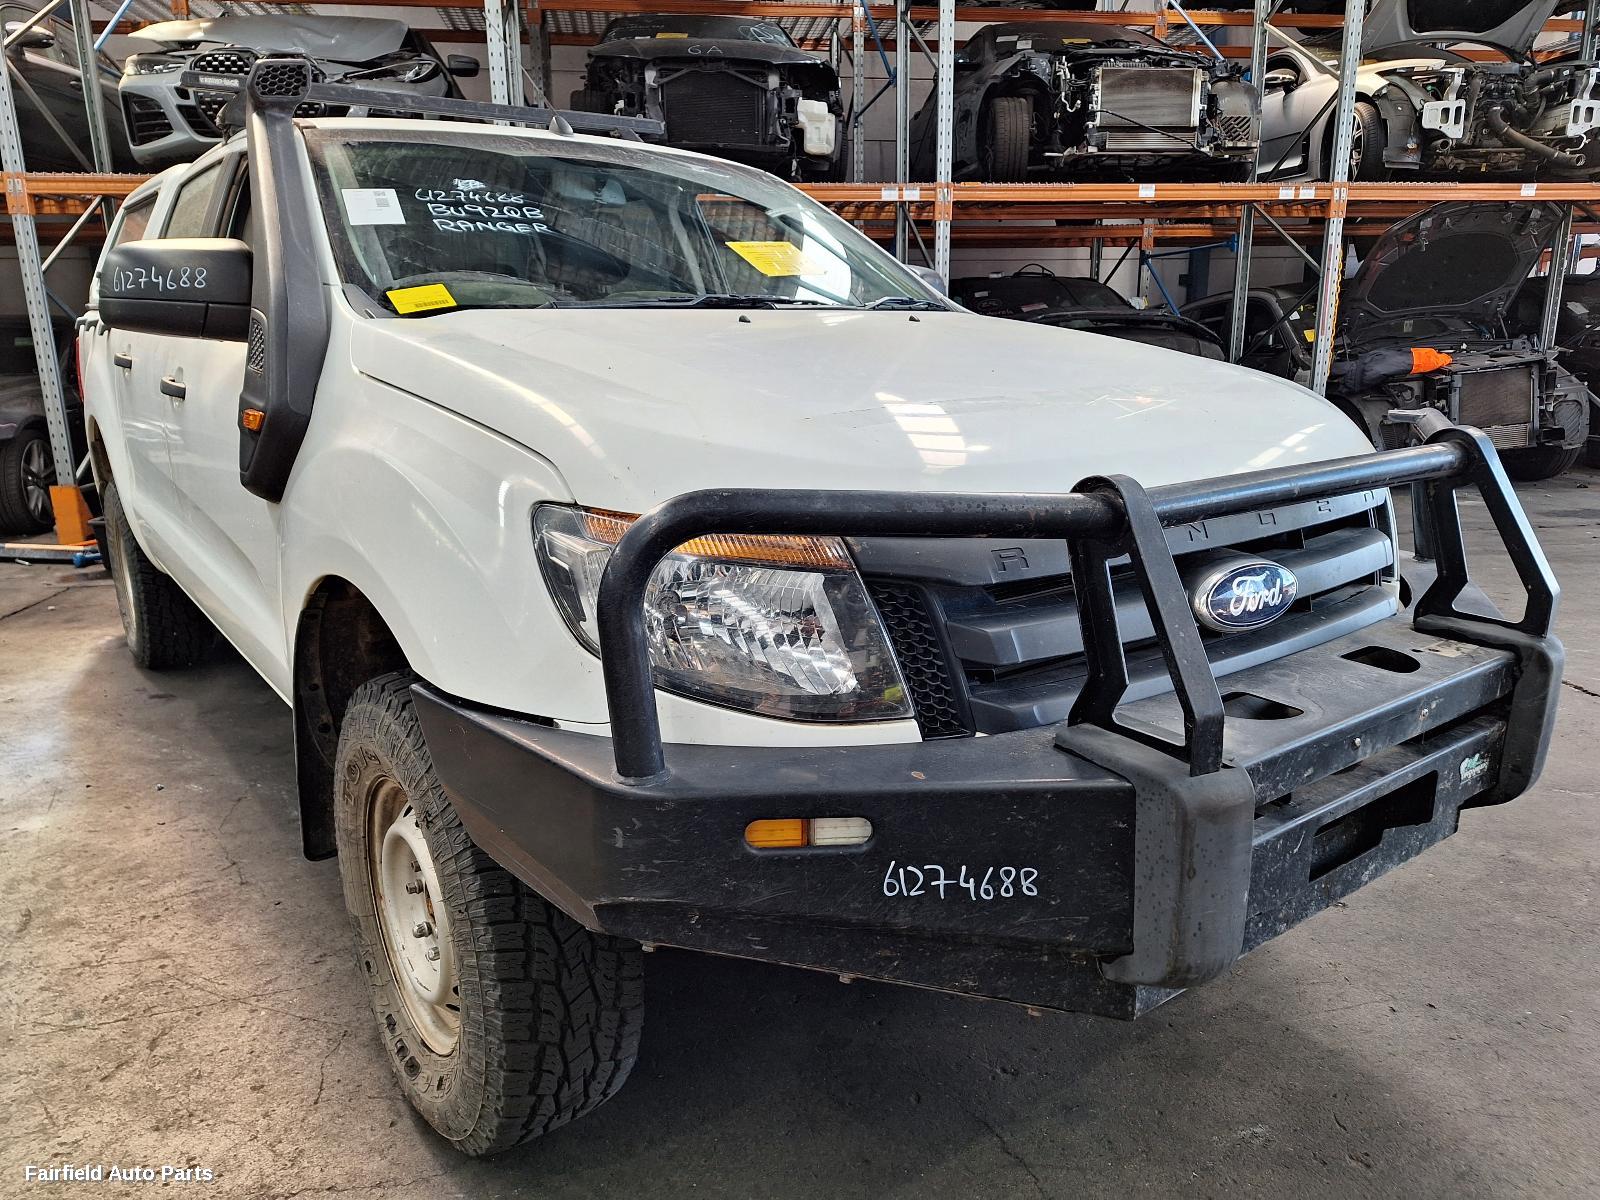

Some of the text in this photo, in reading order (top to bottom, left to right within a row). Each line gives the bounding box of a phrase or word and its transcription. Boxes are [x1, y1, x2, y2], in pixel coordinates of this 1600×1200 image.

[432, 218, 553, 234] RANGER
[113, 265, 207, 292] 61274688
[1229, 570, 1283, 617] Ford
[883, 860, 1038, 900] 61274688
